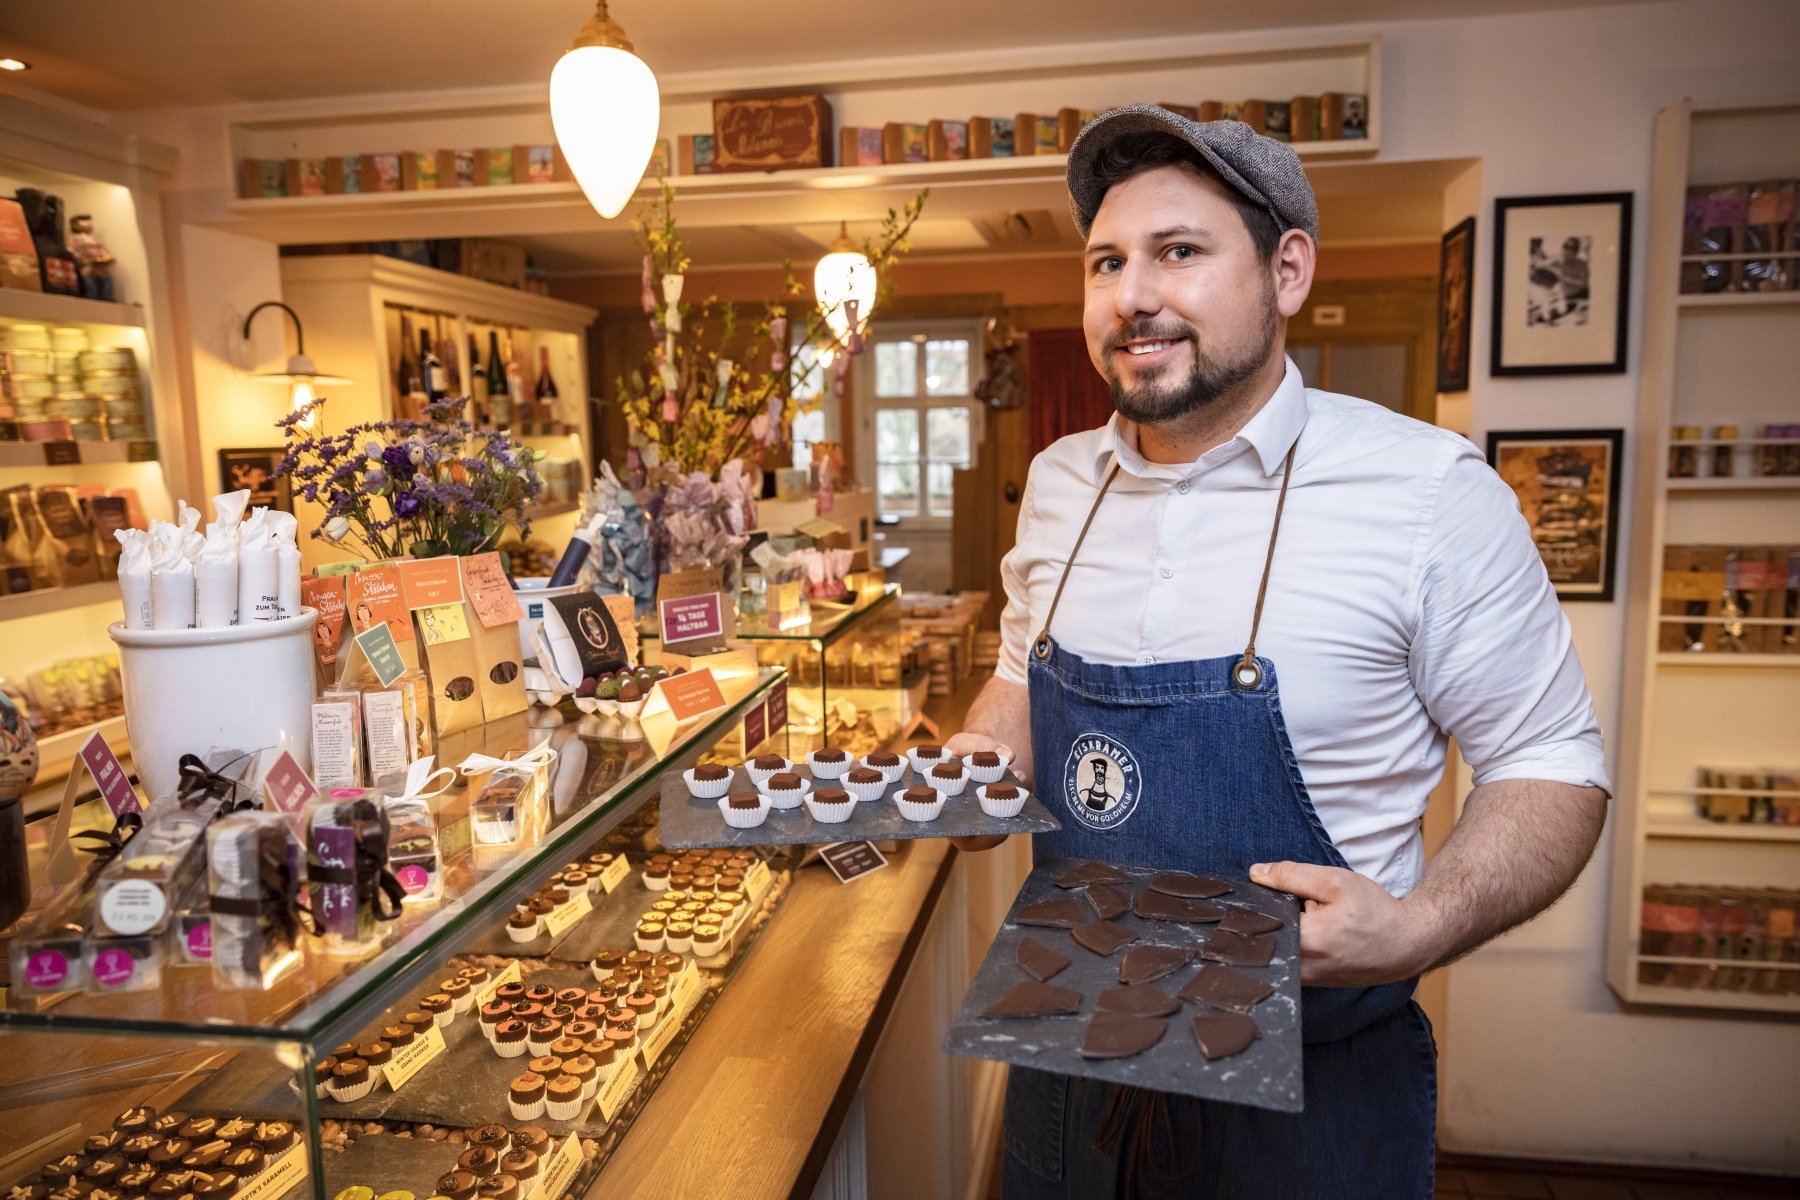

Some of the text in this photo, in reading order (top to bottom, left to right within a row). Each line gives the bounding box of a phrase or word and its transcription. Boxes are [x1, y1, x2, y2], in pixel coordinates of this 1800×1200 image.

[688, 610, 706, 620] TAGE
[677, 620, 709, 632] HALTBAR
[1074, 740, 1134, 773] EISKRÄMER
[1086, 811, 1099, 822] VON
[1100, 792, 1133, 822] GOLDHELM
[401, 1056, 414, 1070] GRAND
[262, 1161, 293, 1188] KARAMELL
